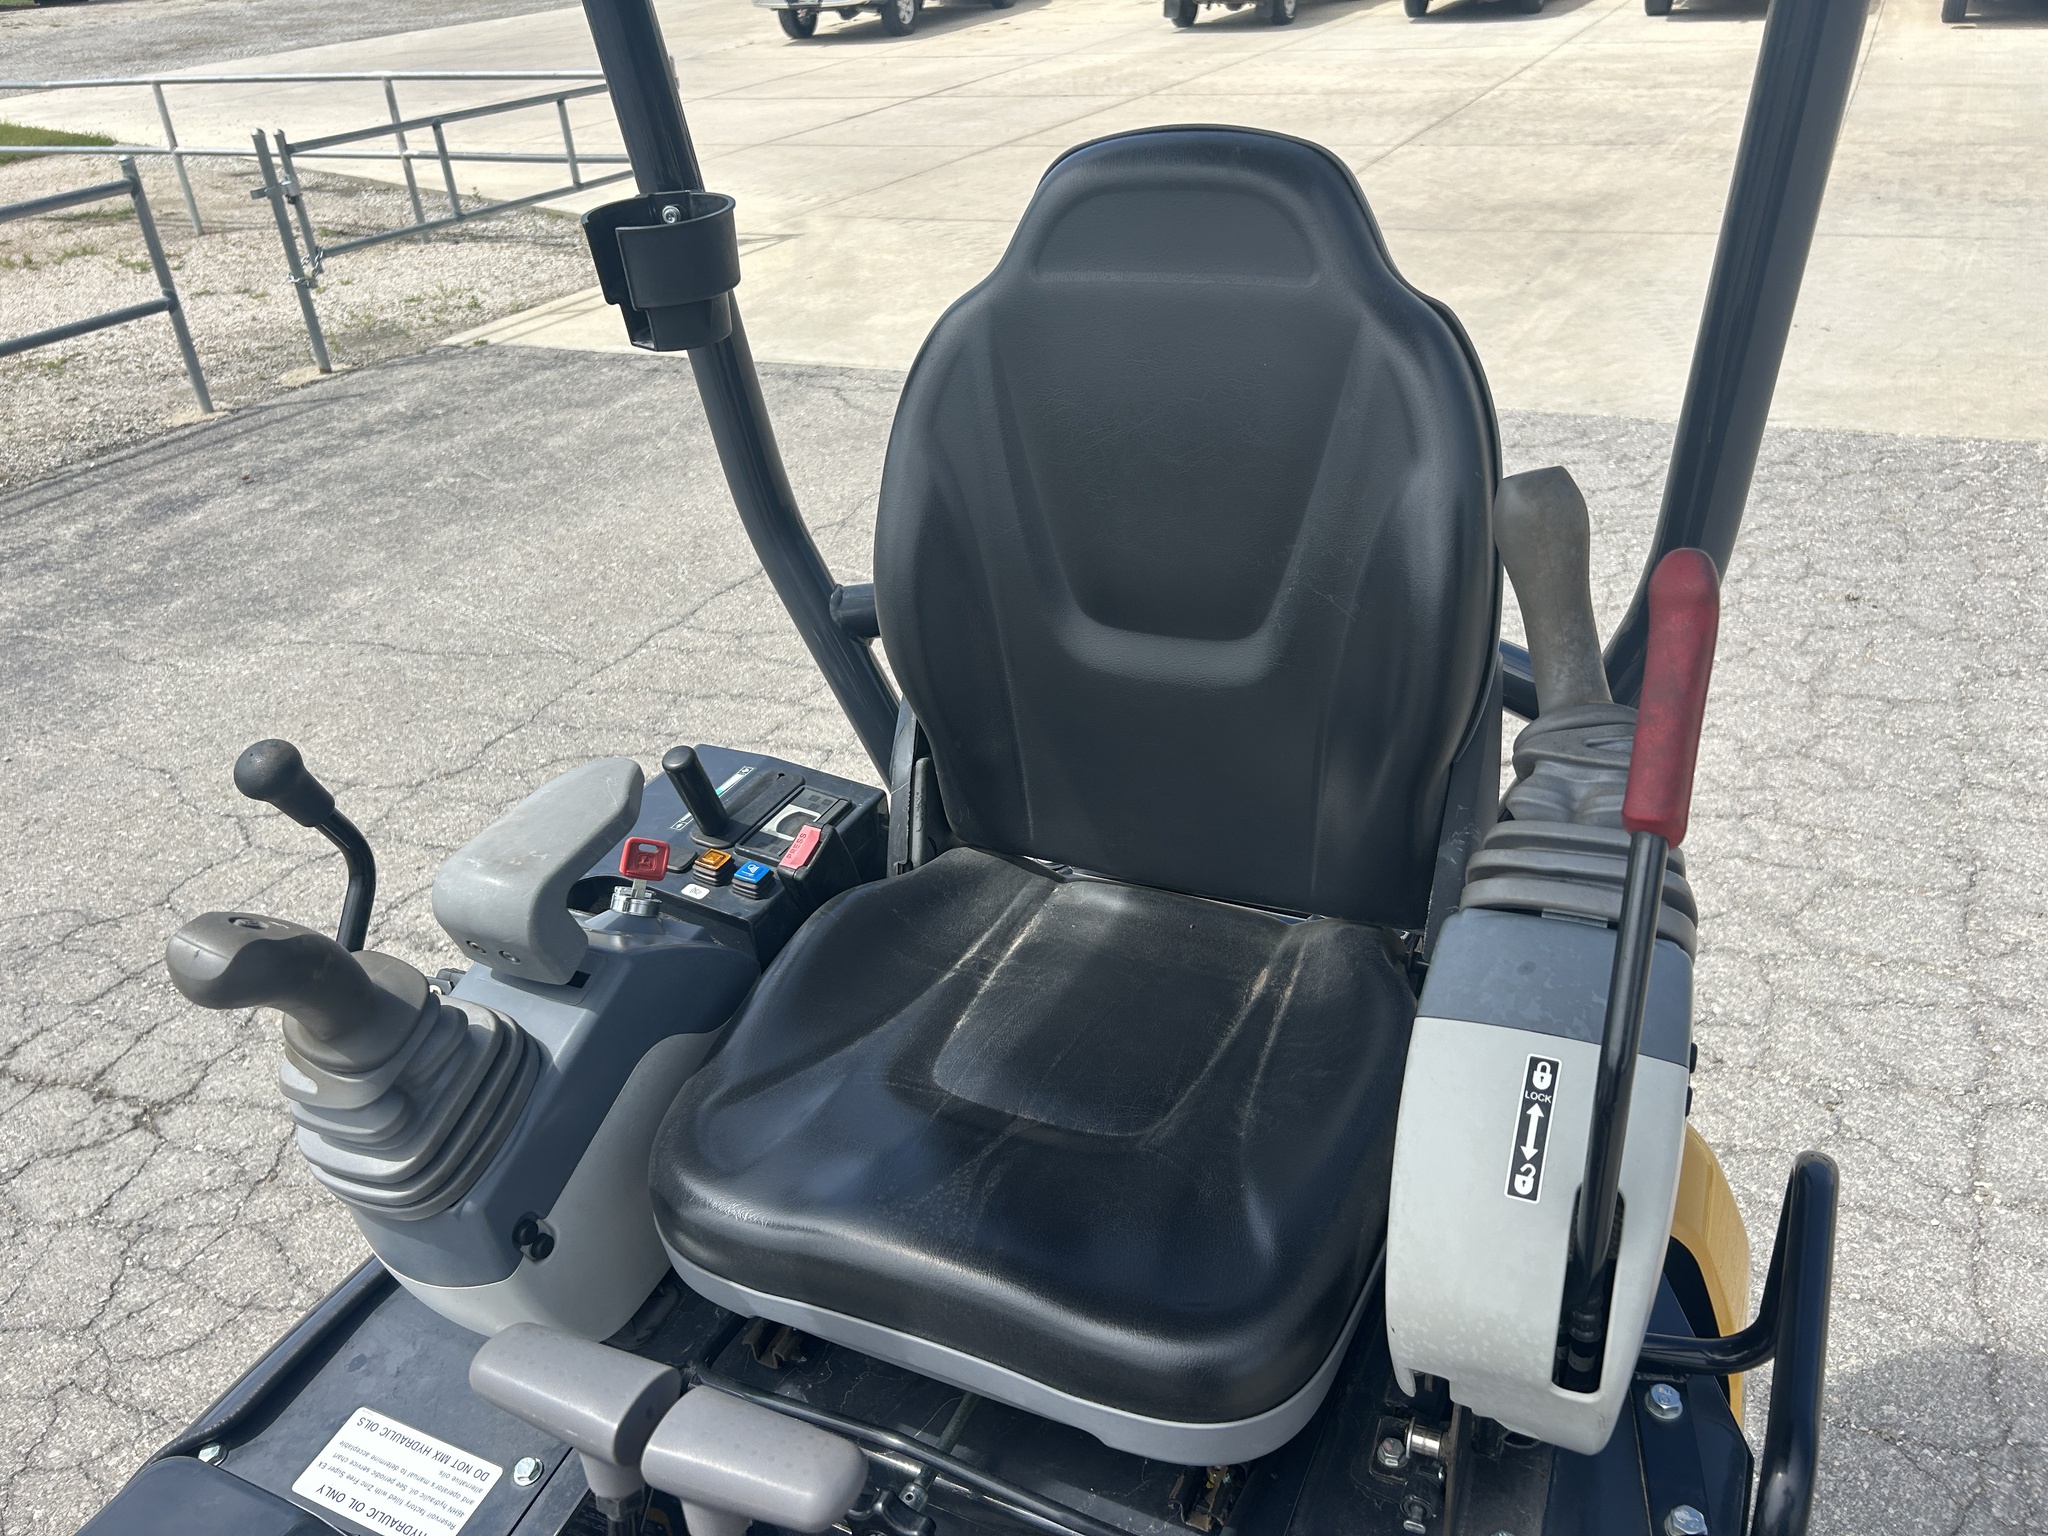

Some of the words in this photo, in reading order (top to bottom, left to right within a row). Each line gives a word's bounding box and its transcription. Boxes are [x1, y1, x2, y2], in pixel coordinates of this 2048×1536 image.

[787, 833, 807, 859] PRESS
[1524, 1090, 1552, 1103] LOCK
[357, 1417, 379, 1432] OILS
[339, 1440, 370, 1457] acceptable
[379, 1427, 432, 1456] HYDRAULIC
[332, 1453, 349, 1463] chart
[371, 1455, 399, 1471] determine
[432, 1450, 451, 1464] MIX
[327, 1465, 345, 1478] Super
[349, 1459, 370, 1473] service
[450, 1459, 473, 1474] NOT
[346, 1474, 360, 1484] Free
[370, 1470, 396, 1485] periodic
[407, 1472, 430, 1485] manual
[473, 1469, 490, 1482] DO
[360, 1480, 374, 1492] Zinc
[395, 1481, 408, 1491] See
[409, 1487, 419, 1496] oil.
[451, 1476, 483, 1494] alternative
[316, 1484, 346, 1503] ONLY
[375, 1487, 387, 1498] with
[348, 1497, 366, 1512] OIL
[387, 1494, 404, 1506] filled
[419, 1492, 448, 1510] hydraulic
[461, 1496, 475, 1505] and
[404, 1500, 426, 1516] factory
[426, 1512, 456, 1530] Reservoir
